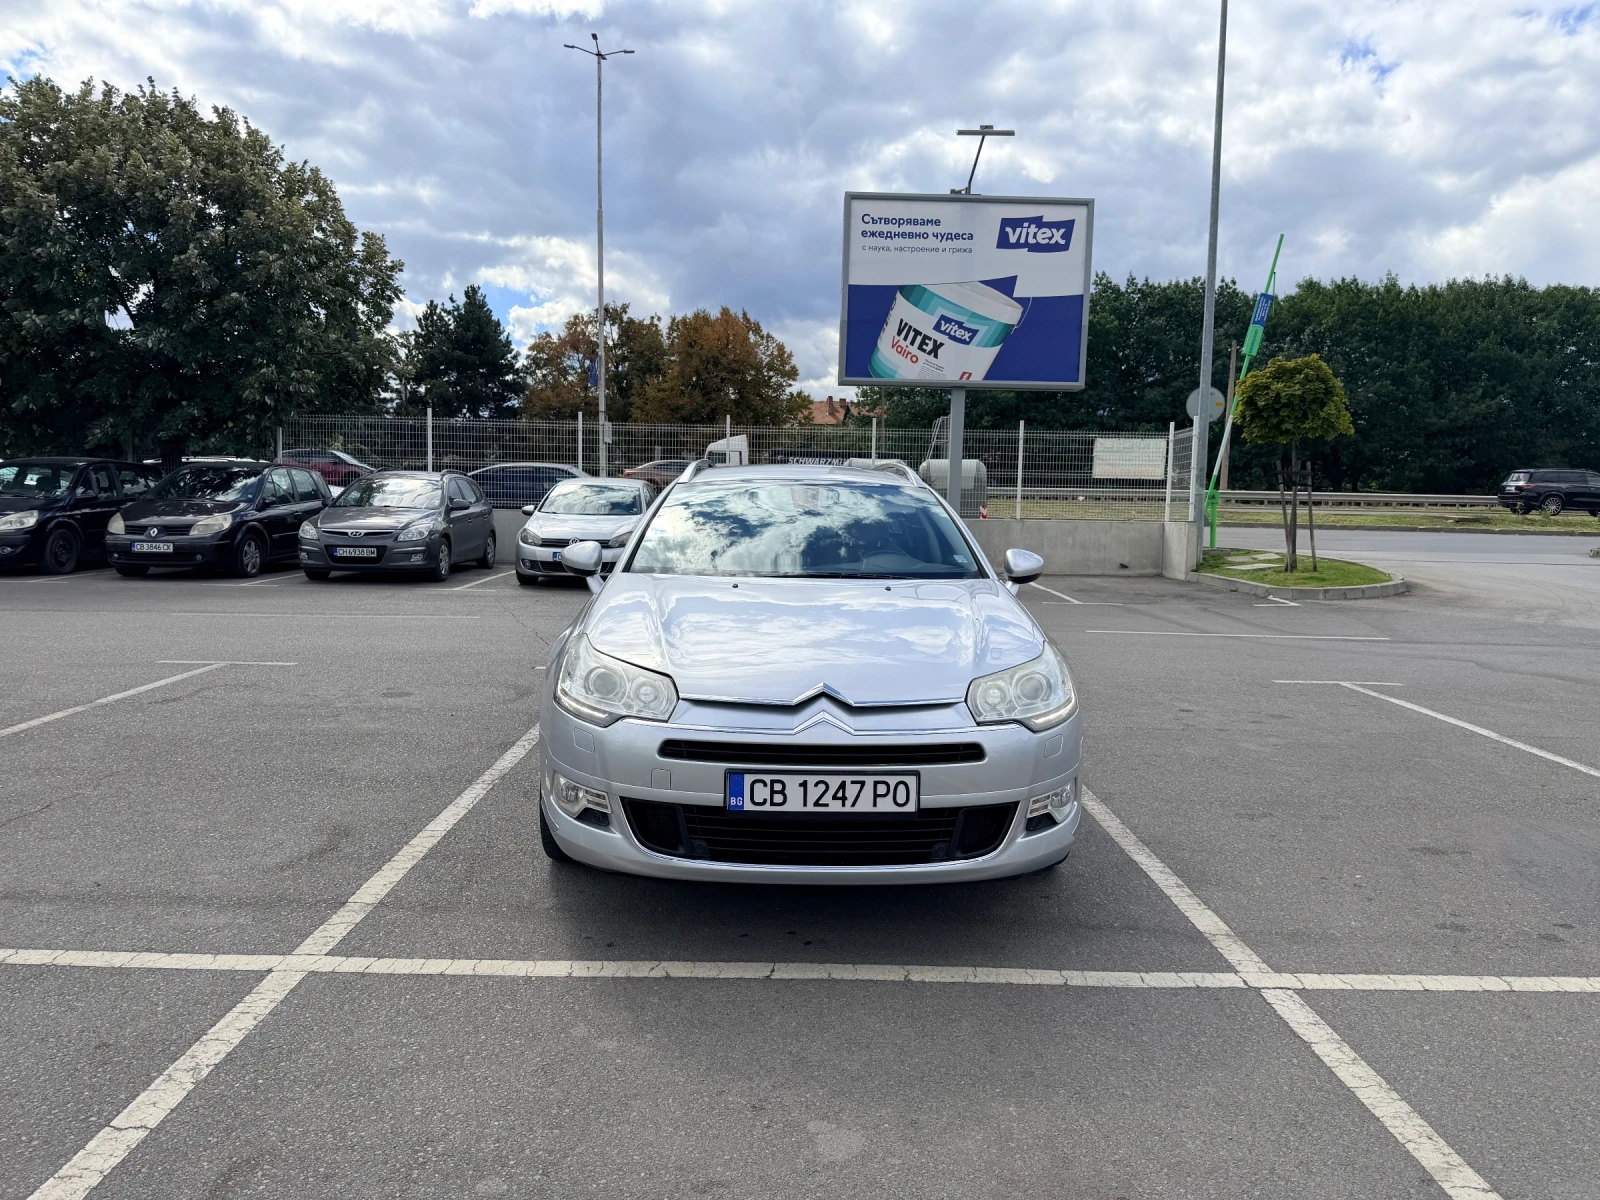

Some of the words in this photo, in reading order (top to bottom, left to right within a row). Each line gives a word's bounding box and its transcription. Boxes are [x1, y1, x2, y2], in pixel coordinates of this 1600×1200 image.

[861, 213, 941, 228] Сътворяваме
[861, 229, 929, 240] ежедневно
[932, 231, 974, 243] чудеса
[1005, 222, 1066, 245] vitex
[868, 244, 892, 253] наука,
[894, 245, 940, 254] настроение
[948, 246, 973, 255] грижа
[896, 317, 945, 360] VITEX
[940, 320, 973, 342] vitex
[891, 335, 919, 364] Vairo
[136, 543, 145, 551] CB
[145, 543, 162, 551] 3846
[338, 548, 347, 556] CH
[348, 548, 365, 556] 6938
[730, 797, 743, 806] BG
[749, 778, 788, 807] CB
[798, 780, 866, 808] 1247
[872, 780, 910, 808] PO
